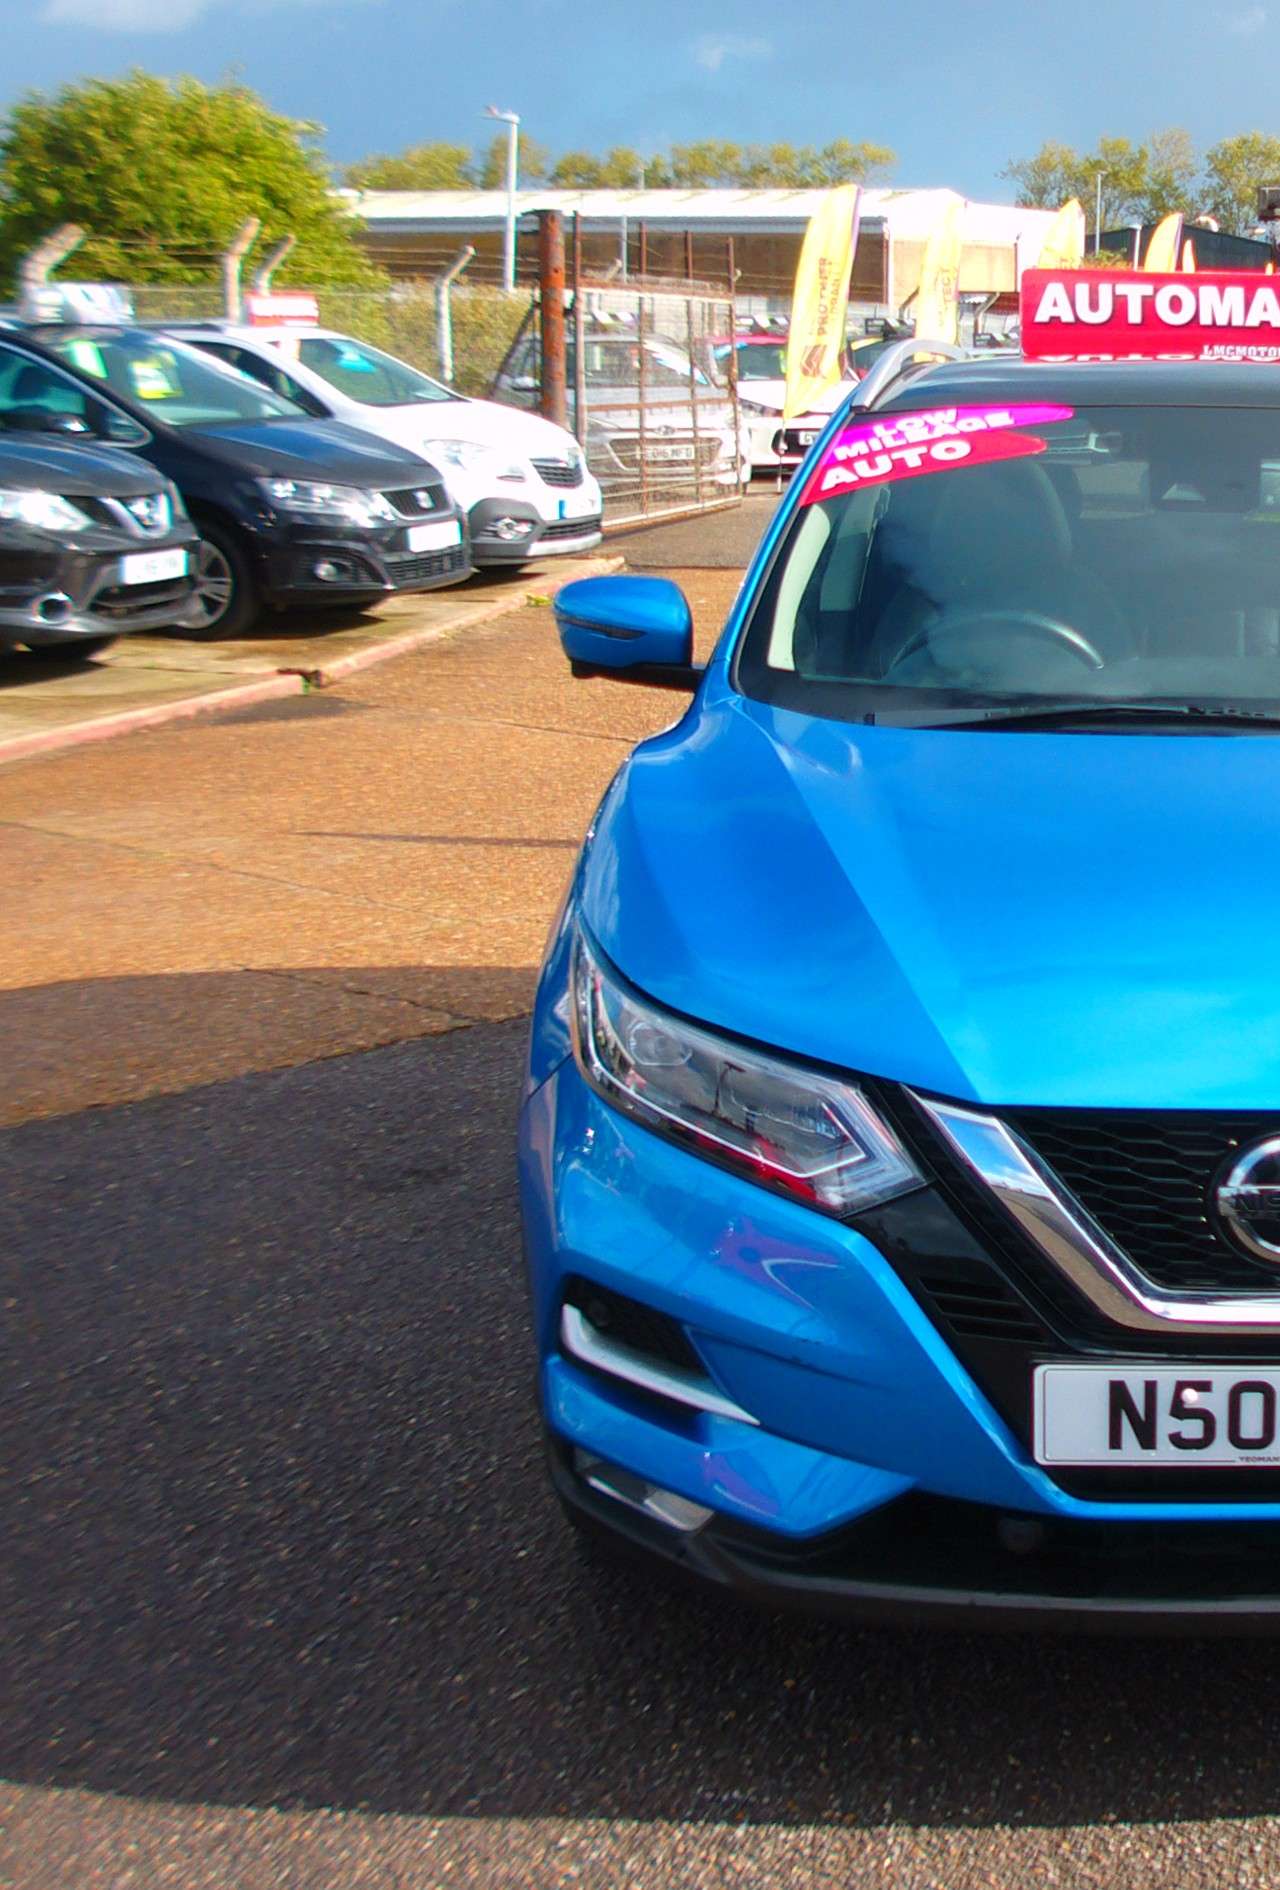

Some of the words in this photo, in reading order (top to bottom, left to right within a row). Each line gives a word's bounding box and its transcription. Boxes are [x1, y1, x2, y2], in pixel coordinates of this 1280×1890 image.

[832, 411, 1015, 461] MILEAGE
[873, 407, 958, 438] LOW
[820, 439, 972, 491] AUTO
[1107, 1379, 1277, 1451] N50
